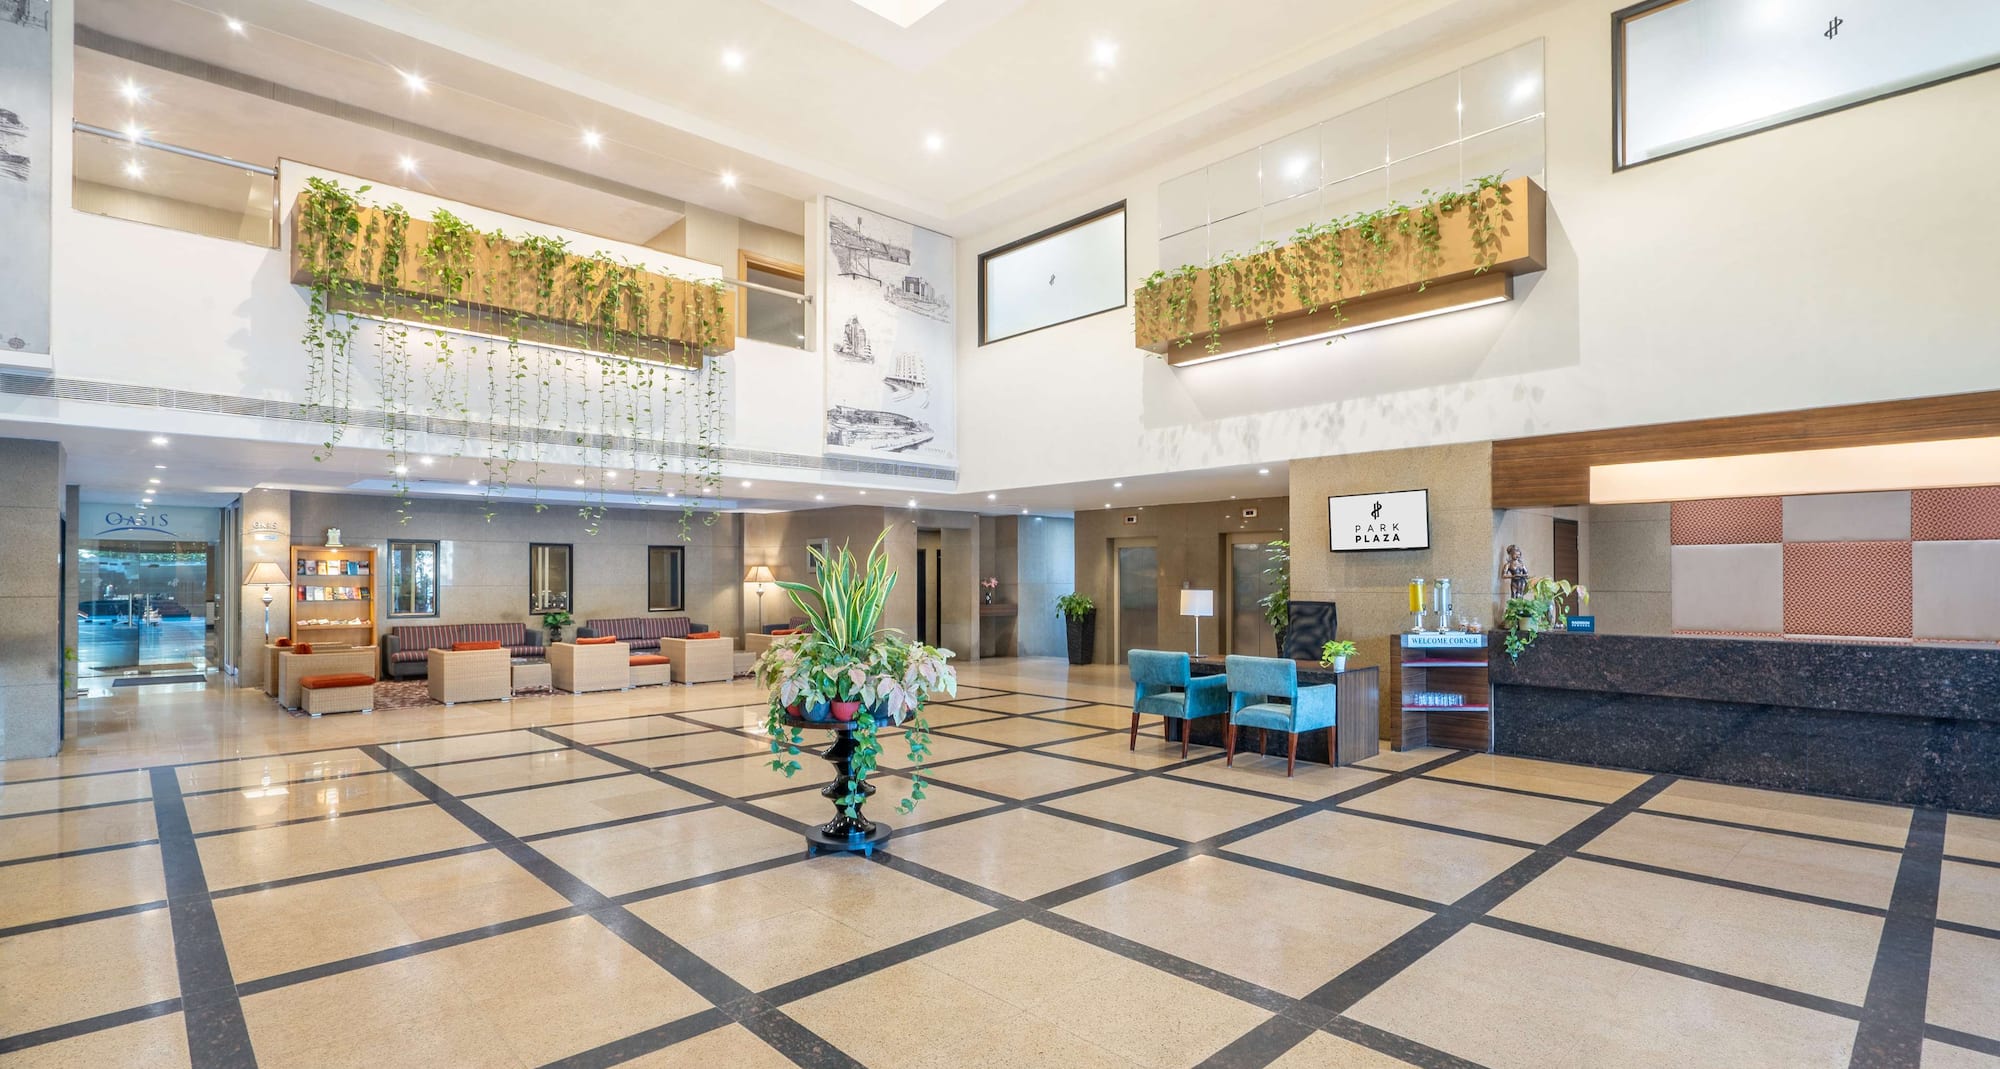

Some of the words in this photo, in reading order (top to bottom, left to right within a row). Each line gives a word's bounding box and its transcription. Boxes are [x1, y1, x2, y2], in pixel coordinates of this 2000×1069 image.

[105, 512, 169, 527] OASIS
[1355, 523, 1400, 533] PARK
[1355, 533, 1400, 543] PLAZA
[1411, 637, 1447, 645] WELCOME
[1449, 637, 1478, 645] CORNER
